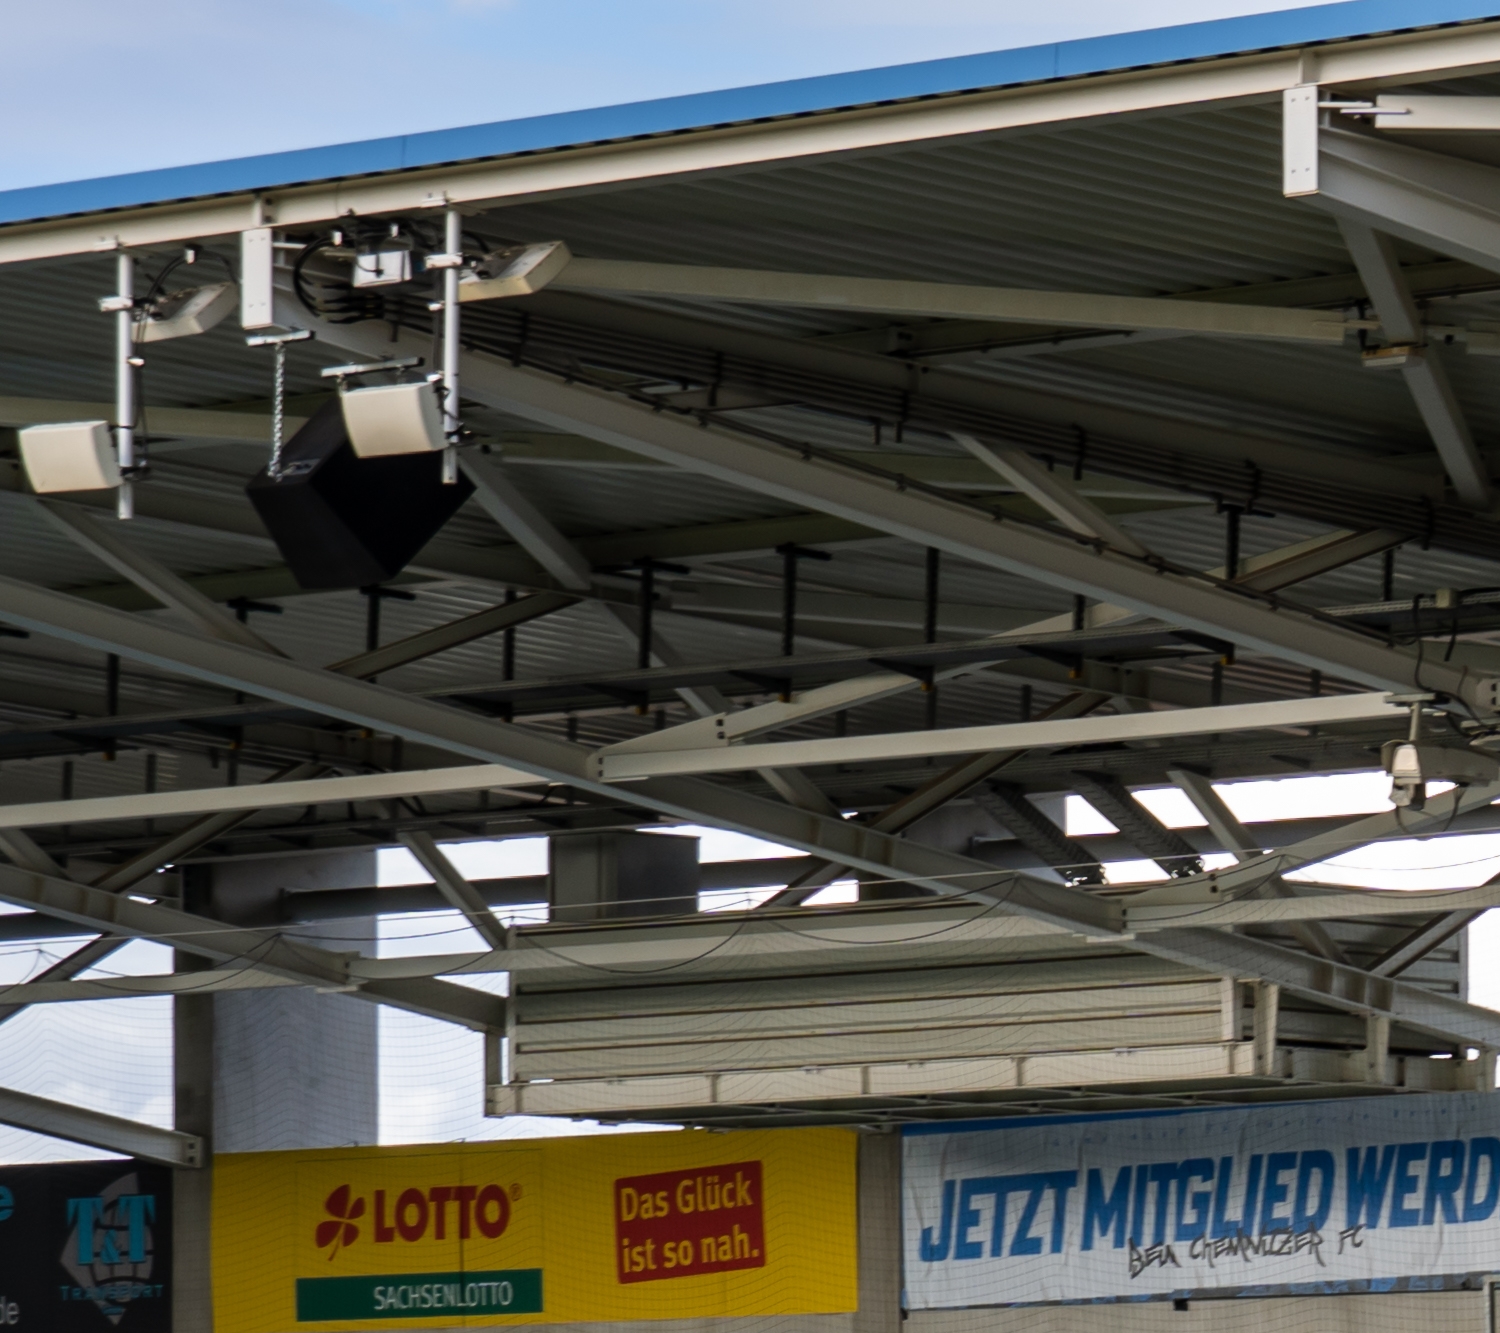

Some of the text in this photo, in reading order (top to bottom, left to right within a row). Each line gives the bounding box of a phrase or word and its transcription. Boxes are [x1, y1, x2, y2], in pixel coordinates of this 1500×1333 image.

[373, 1184, 512, 1243] LOTTO
[620, 1170, 754, 1221] Das Glück
[920, 1168, 1080, 1262] JETZT
[1081, 1148, 1335, 1252] MITGLIED
[622, 1224, 761, 1274] ist so nah.
[1189, 1223, 1326, 1268] CHEMNITZER
[1338, 1223, 1366, 1256] FC
[372, 1279, 514, 1311] SACHSENLOTTO
